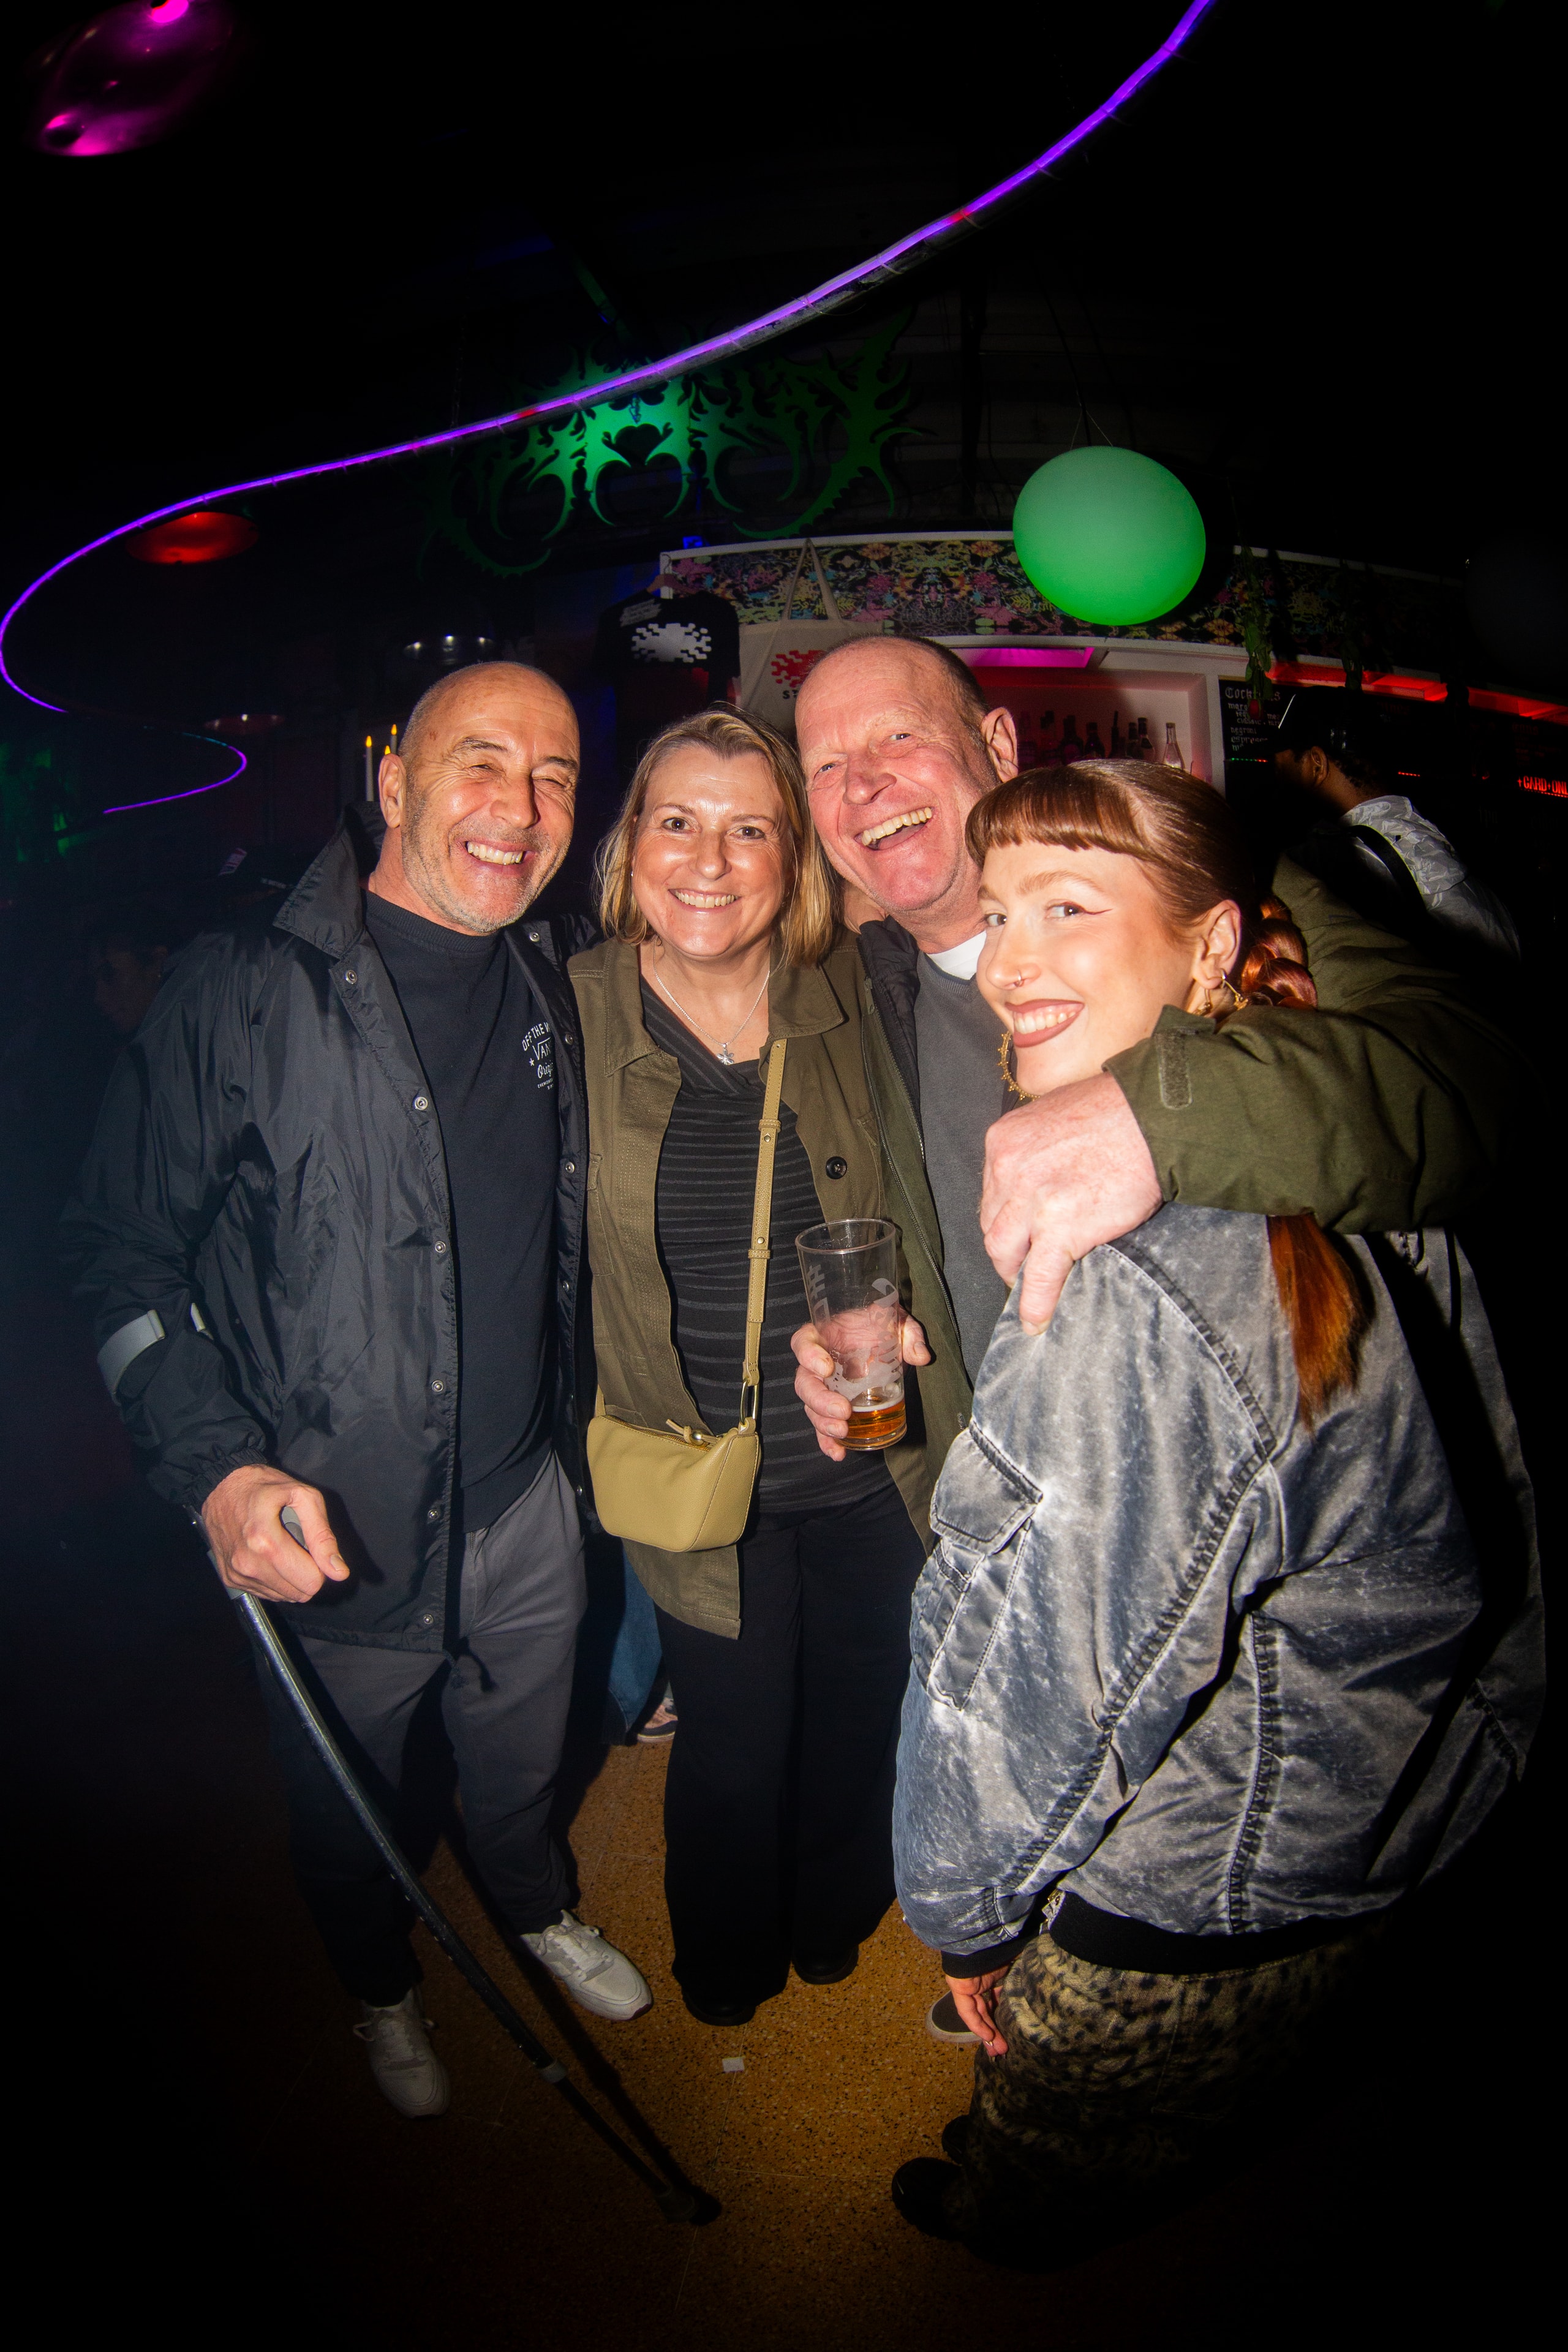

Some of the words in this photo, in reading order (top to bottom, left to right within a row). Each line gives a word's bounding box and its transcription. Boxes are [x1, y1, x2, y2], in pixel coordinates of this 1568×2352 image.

[1523, 775, 1547, 791] CARD
[1552, 780, 1568, 795] ONL
[522, 1031, 532, 1052] OFF
[530, 1023, 545, 1039] THE
[532, 1036, 551, 1060] VAN
